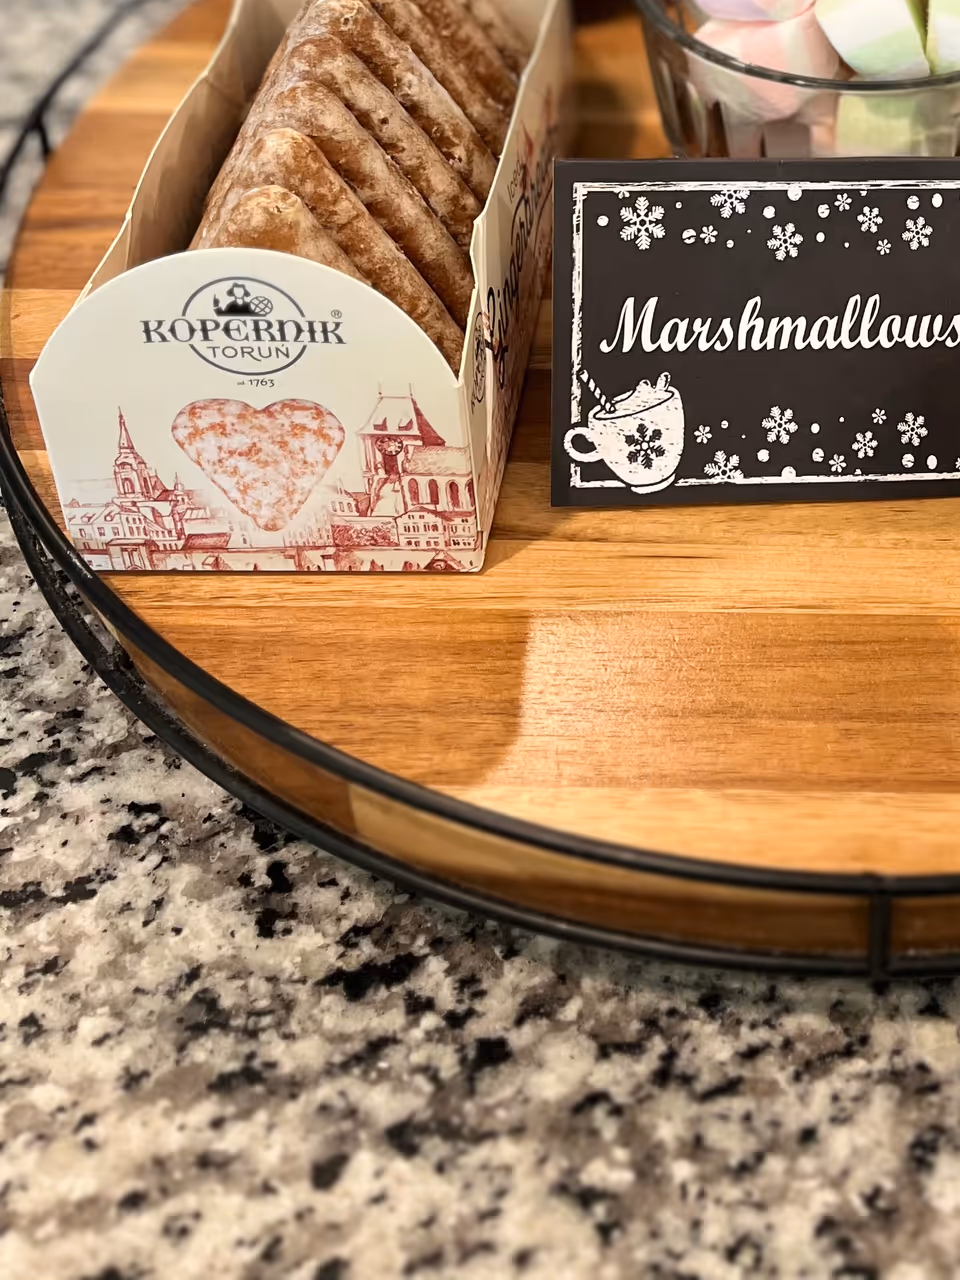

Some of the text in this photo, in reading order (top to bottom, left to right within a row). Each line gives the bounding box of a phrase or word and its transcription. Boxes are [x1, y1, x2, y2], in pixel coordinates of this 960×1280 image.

[140, 318, 347, 345] KOPERNIK
[206, 344, 290, 362] TORUŃ
[248, 378, 275, 387] 1763
